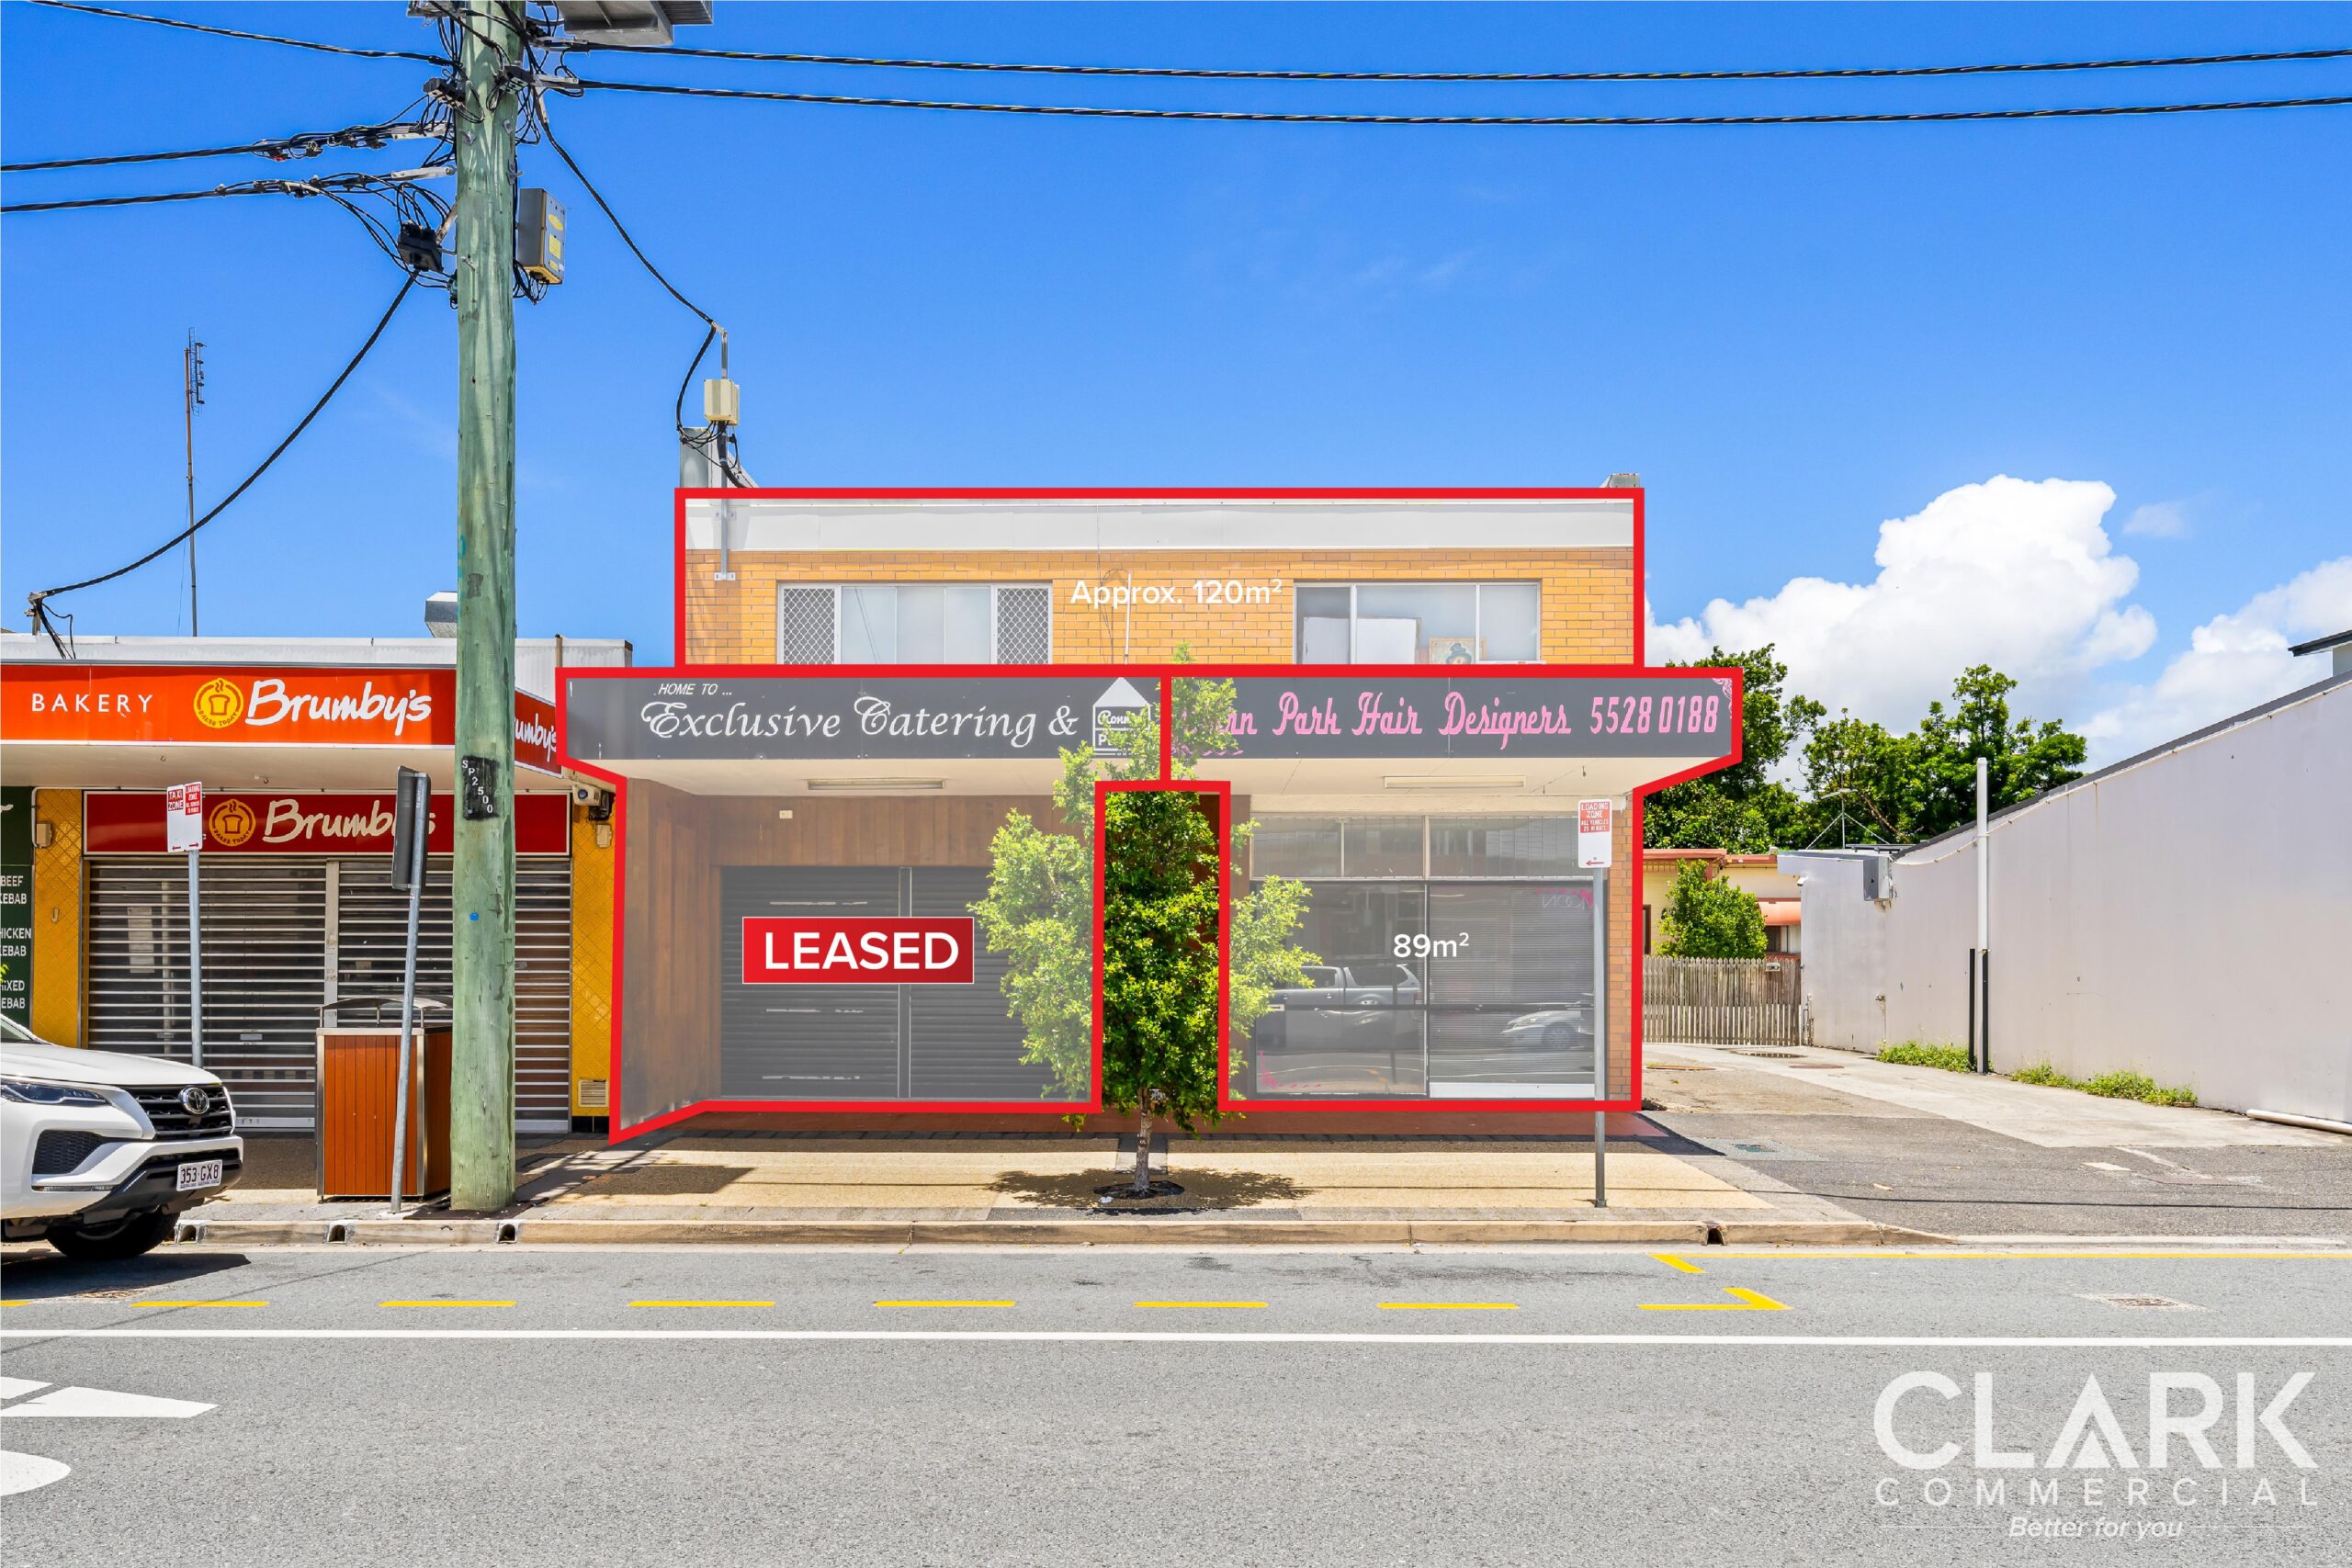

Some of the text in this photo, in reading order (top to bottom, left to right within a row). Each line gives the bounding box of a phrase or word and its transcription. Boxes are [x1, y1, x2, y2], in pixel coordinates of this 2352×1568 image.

[658, 682, 695, 695] HOME
[701, 682, 718, 695] TO
[31, 693, 153, 713] BAKERY
[244, 678, 432, 737] Brumby's
[640, 695, 1080, 748] Exclusive Catering &
[1272, 691, 1341, 736] Park
[1351, 691, 1423, 736] Hair
[1437, 691, 1572, 750] Designers
[1589, 695, 1653, 734] 5528
[1657, 695, 1719, 734] 0188
[168, 789, 183, 800] TAXI
[168, 800, 184, 811] ZONE
[1581, 802, 1609, 811] LOADING
[262, 798, 436, 843] Brumb
[1587, 810, 1603, 818] ZONE
[0, 945, 27, 956] EBAB
